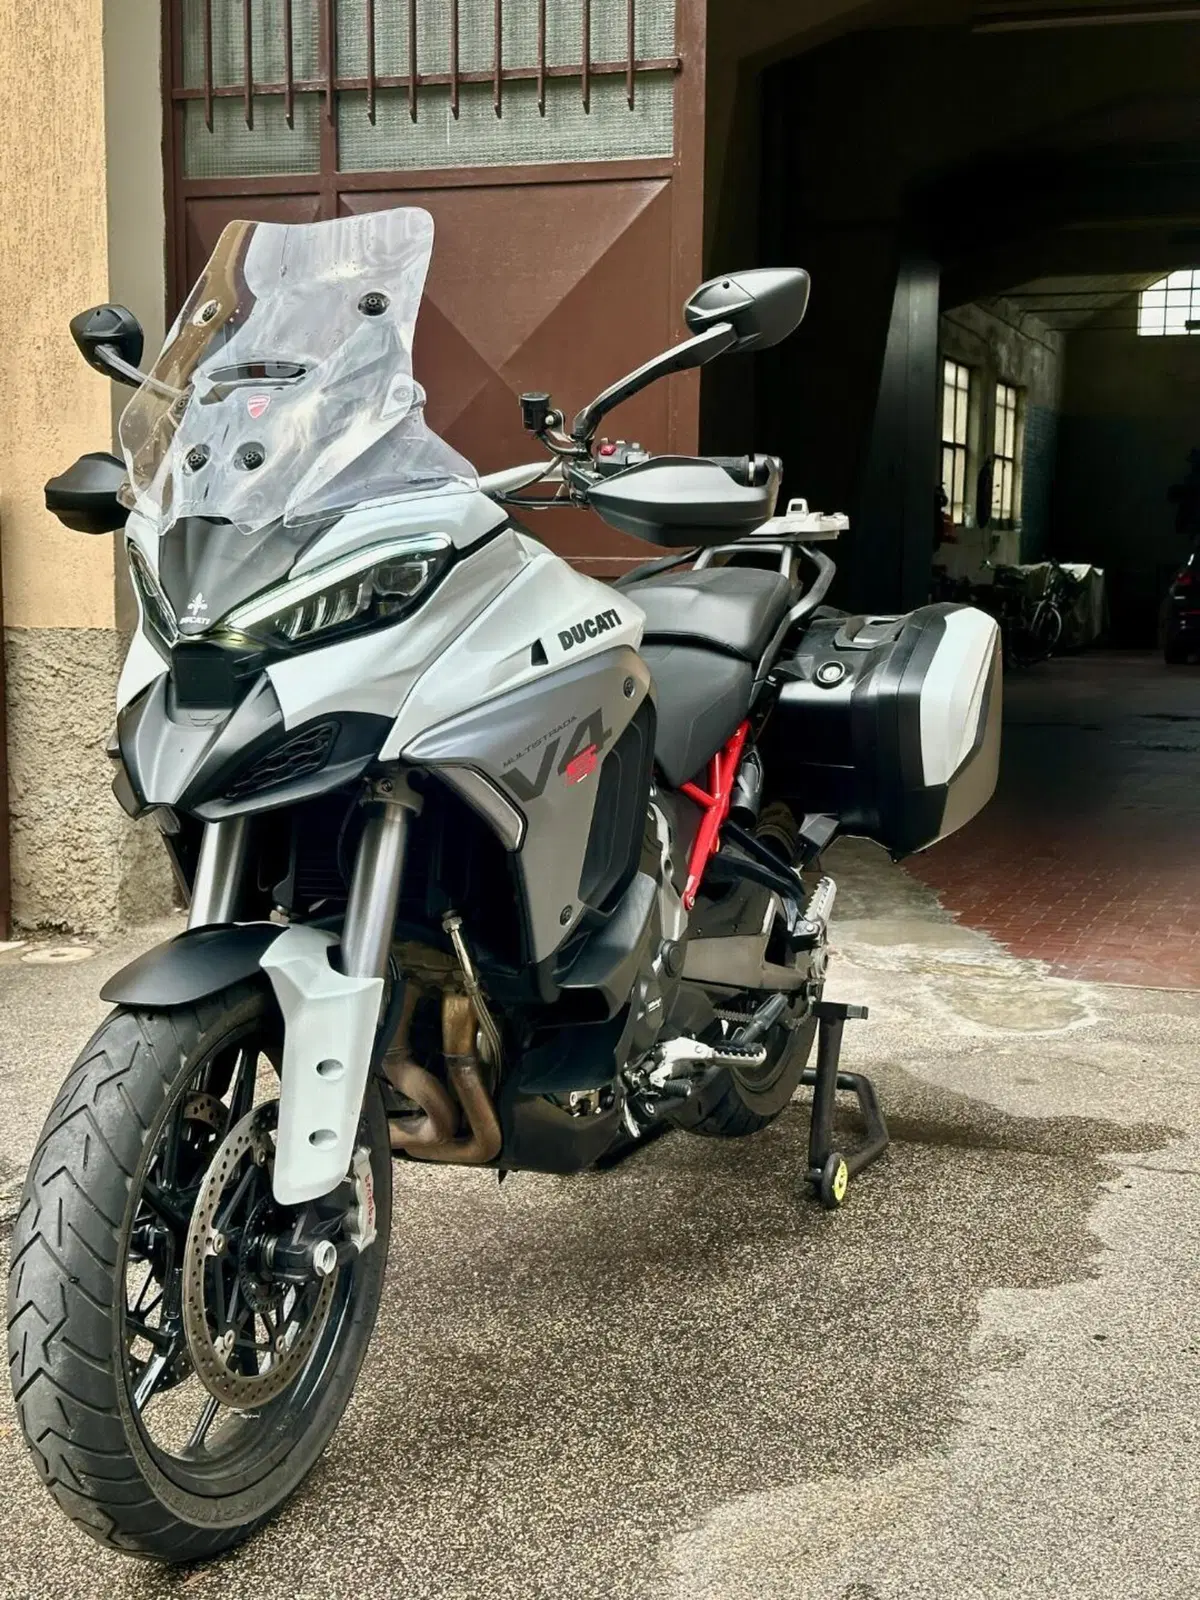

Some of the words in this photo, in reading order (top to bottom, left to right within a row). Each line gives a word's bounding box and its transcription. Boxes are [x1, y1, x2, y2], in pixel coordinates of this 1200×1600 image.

[557, 609, 622, 651] DUCATI
[499, 707, 612, 802] V4
[503, 715, 578, 768] MULTISTRADA
